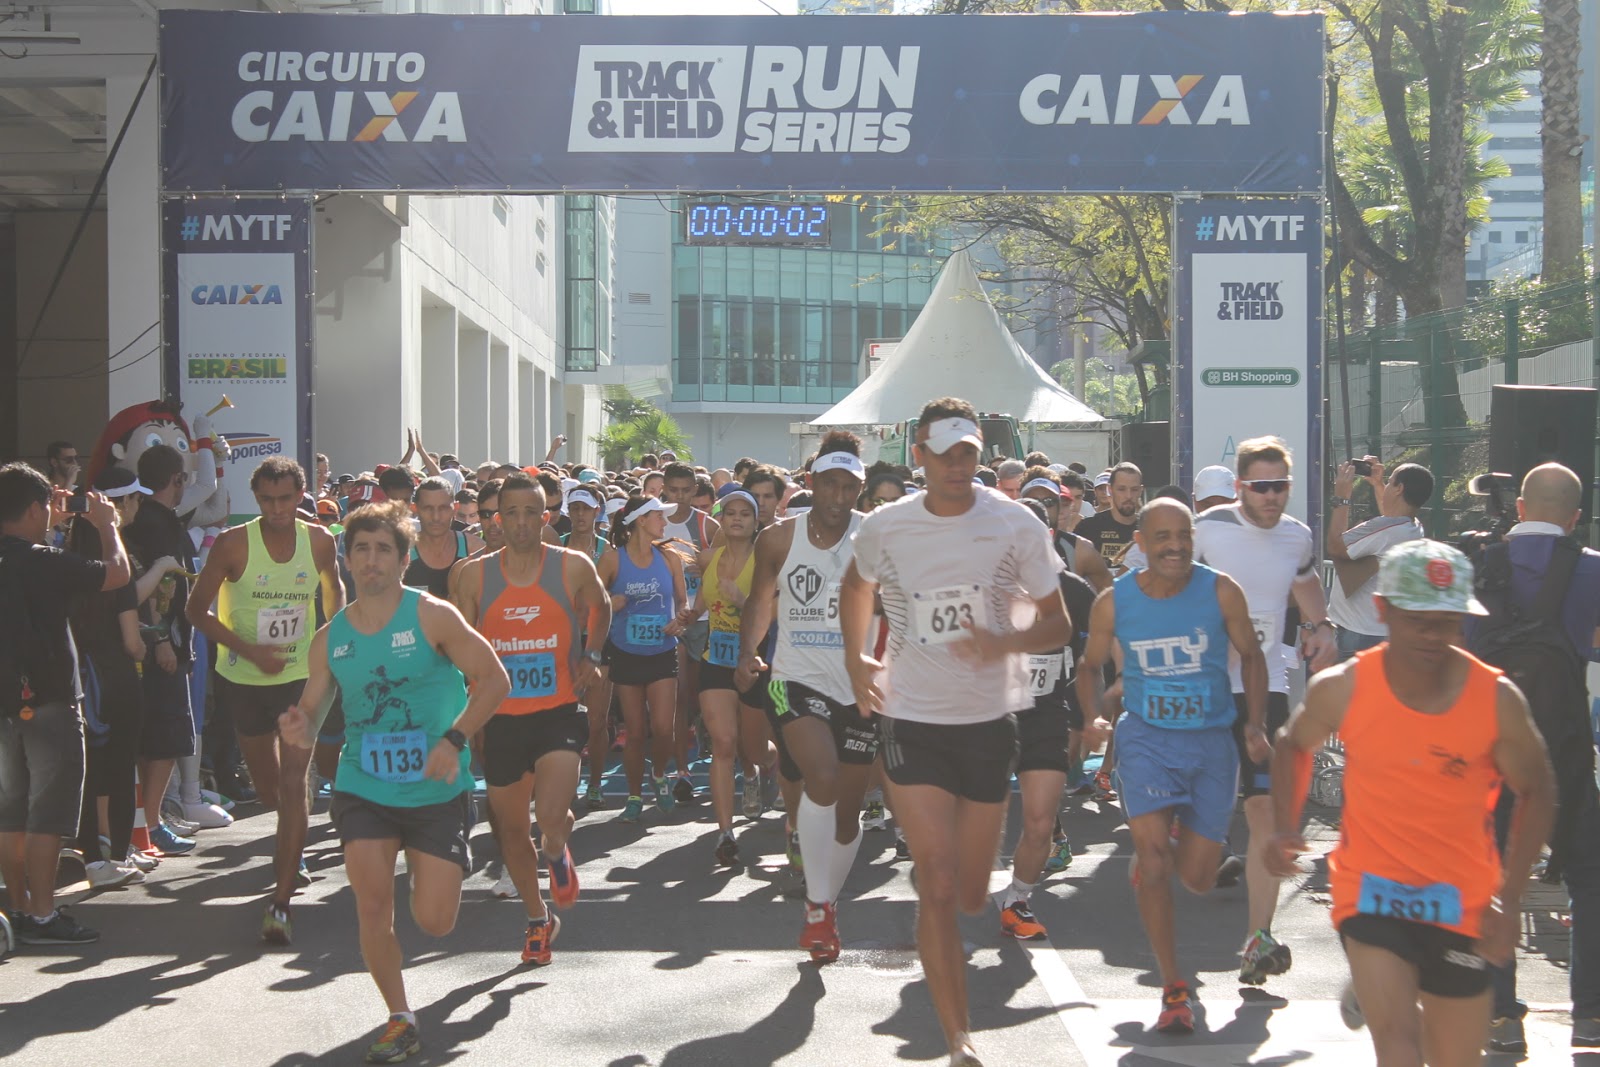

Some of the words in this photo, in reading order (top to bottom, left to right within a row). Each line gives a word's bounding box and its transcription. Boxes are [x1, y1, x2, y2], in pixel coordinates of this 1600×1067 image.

[237, 51, 426, 83] CIRCUITO
[746, 45, 921, 109] RUN
[593, 60, 716, 100] TRACK
[1018, 73, 1251, 126] CAIXA
[231, 90, 468, 143] CAIXA
[740, 111, 911, 153] SERIES
[180, 213, 292, 242] #MYTF
[690, 206, 826, 237] 00:00:02
[1195, 214, 1305, 241] #MYTF
[191, 284, 283, 305] CAIXA
[1220, 281, 1280, 301] TRACK
[188, 358, 287, 379] BRASIL
[1222, 371, 1239, 382] BH
[1240, 371, 1292, 384] Shopping
[227, 441, 282, 462] ponesa
[284, 592, 309, 600] CENTER
[789, 608, 825, 616] CLUBE
[932, 602, 976, 633] 623
[268, 617, 299, 639] 617
[631, 624, 662, 640] 1255
[492, 634, 558, 652] Unimed
[714, 642, 740, 661] 171
[507, 666, 552, 689] 1905
[1149, 695, 1203, 720] 1525
[844, 739, 868, 752] ATLETA
[370, 747, 424, 774] 1133
